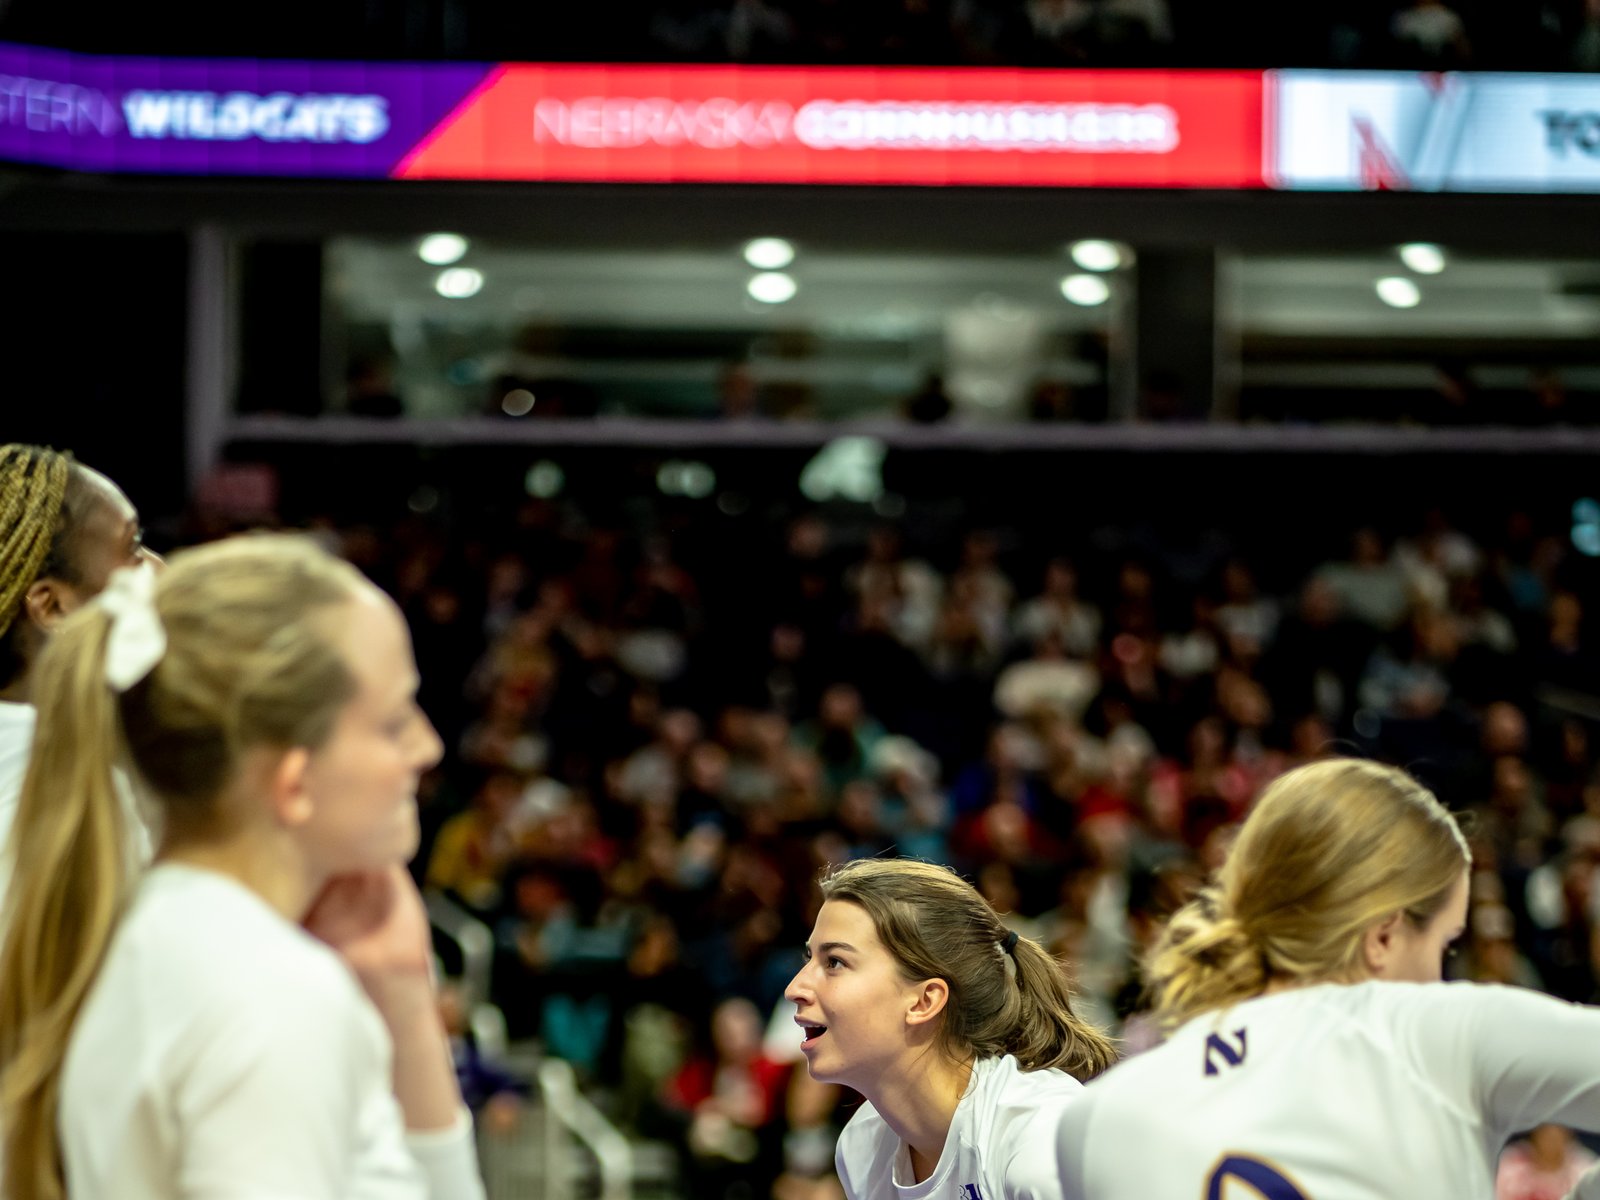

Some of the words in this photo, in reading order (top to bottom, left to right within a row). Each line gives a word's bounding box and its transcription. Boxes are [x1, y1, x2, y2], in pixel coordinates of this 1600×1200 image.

[123, 90, 389, 143] WILDCATS
[534, 97, 795, 149] NEBRASKA
[1203, 1027, 1248, 1077] N
